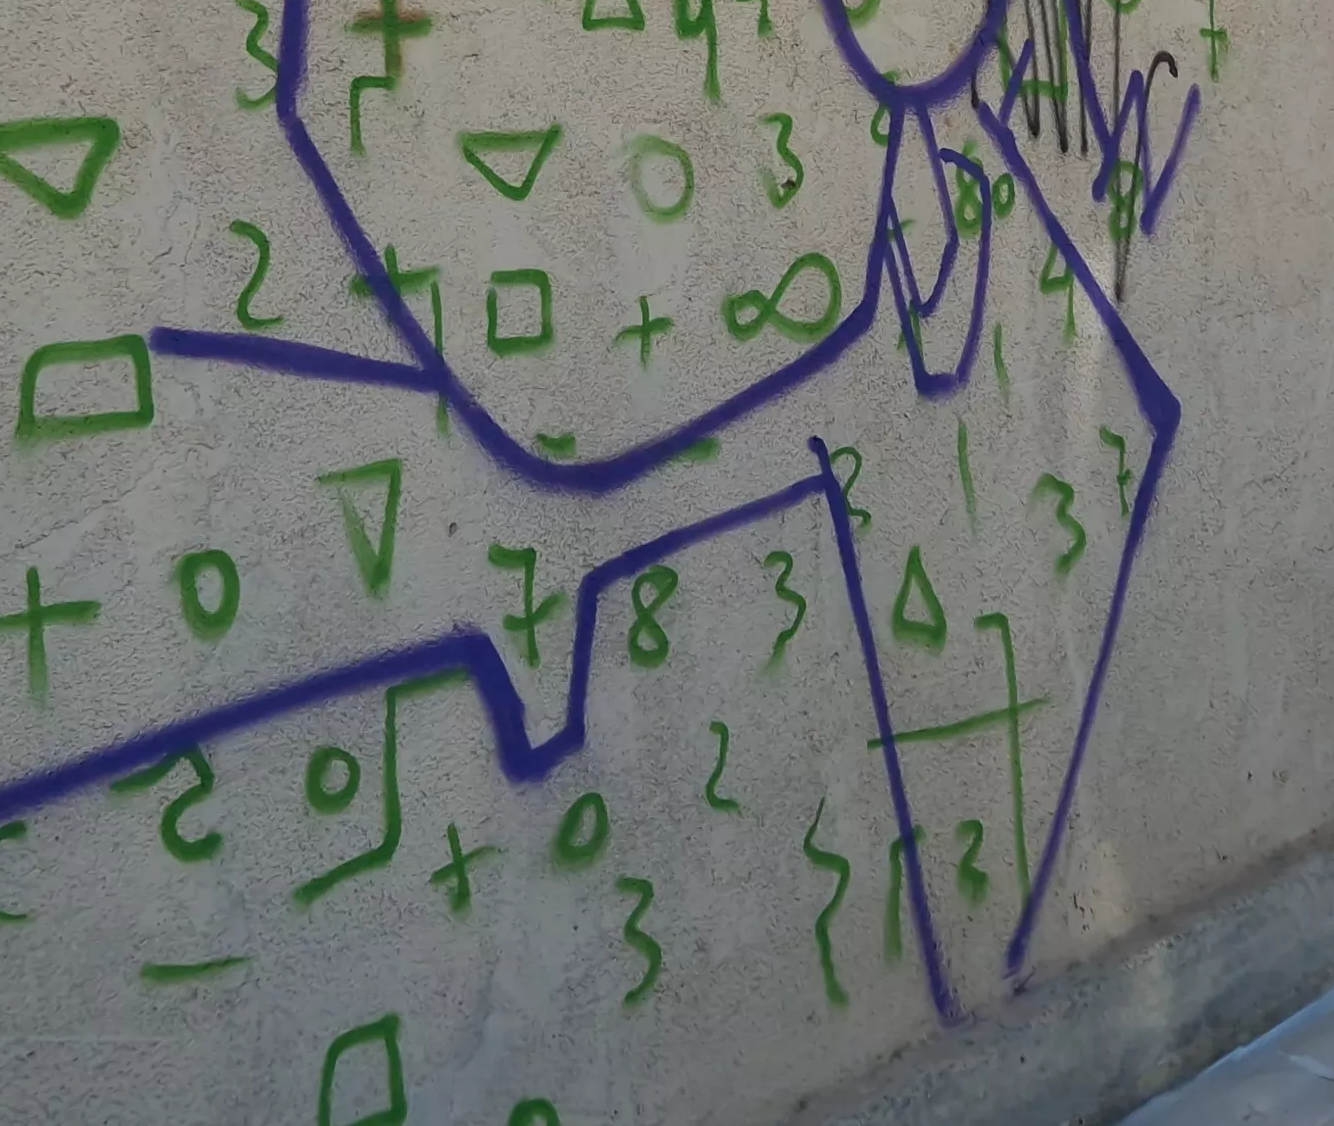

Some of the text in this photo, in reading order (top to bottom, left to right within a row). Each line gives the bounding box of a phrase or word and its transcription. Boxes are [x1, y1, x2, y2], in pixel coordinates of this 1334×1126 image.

[765, 114, 804, 209] 3
[232, 221, 284, 331] 2
[1038, 476, 1087, 574] 3
[629, 567, 679, 669] 8
[705, 722, 740, 813] 2
[617, 877, 663, 1009] 3
